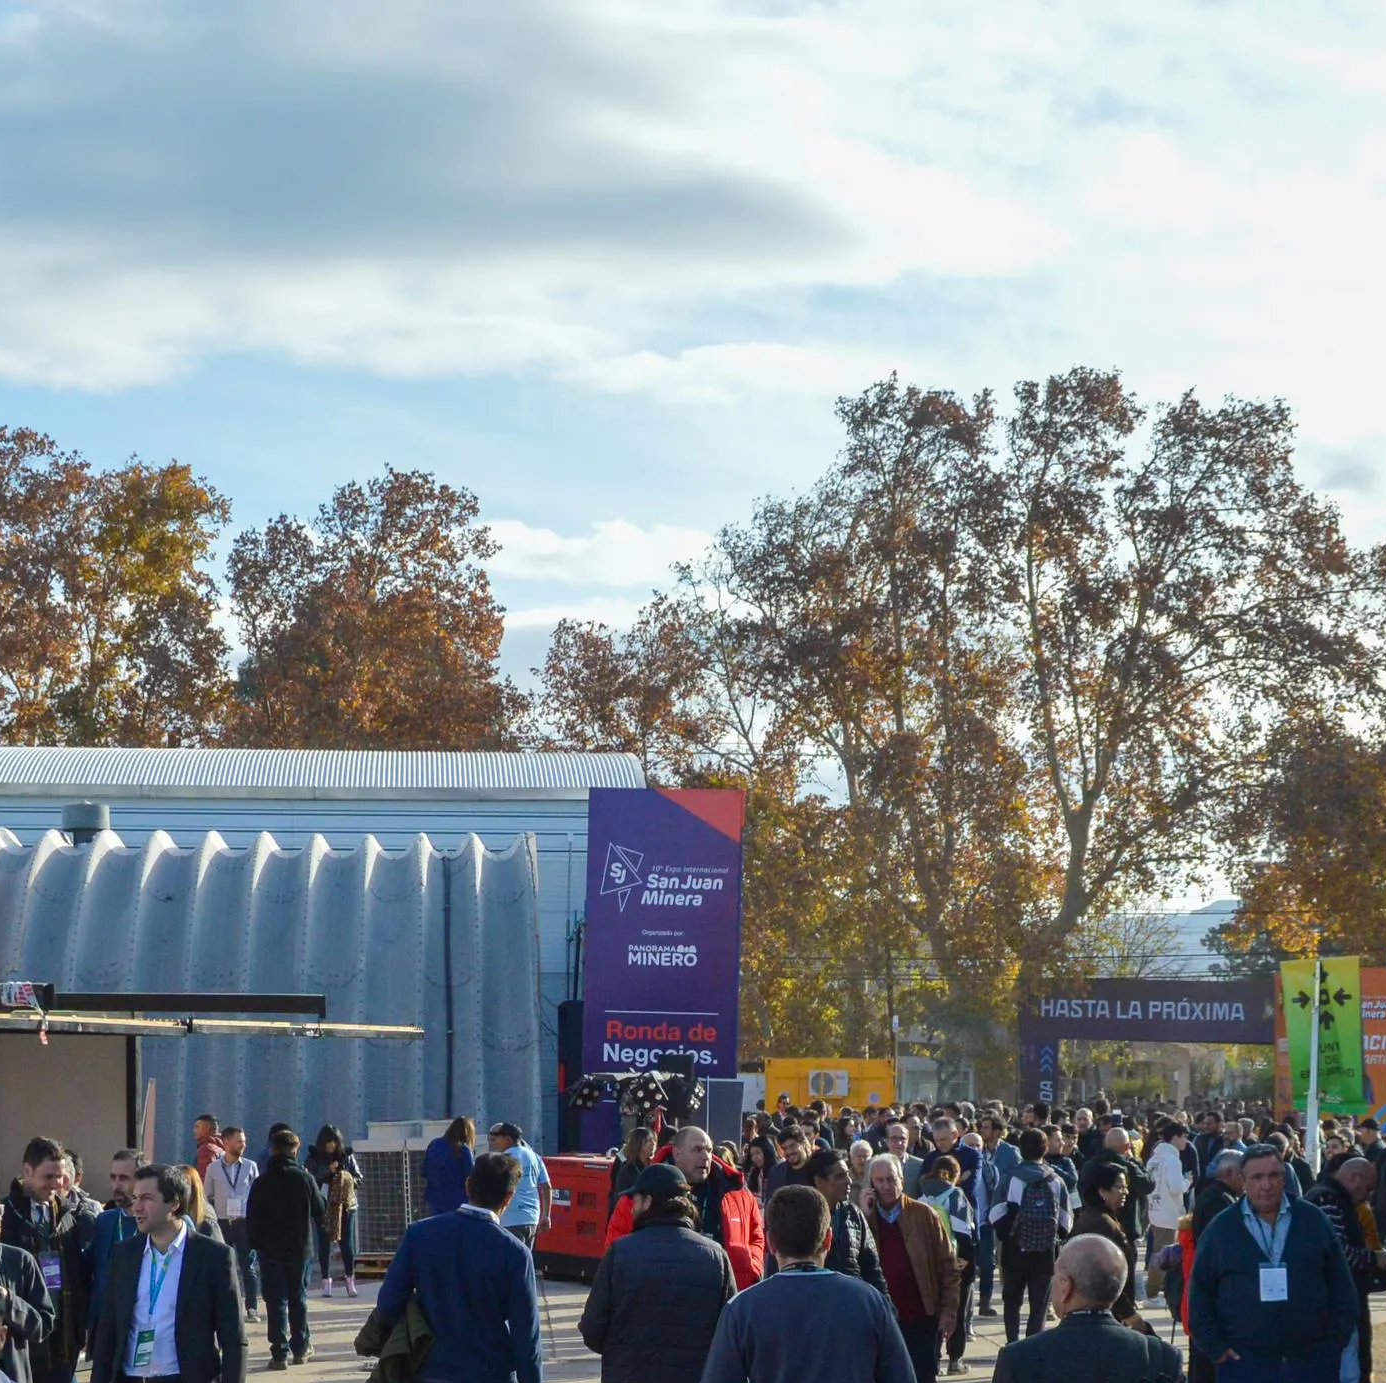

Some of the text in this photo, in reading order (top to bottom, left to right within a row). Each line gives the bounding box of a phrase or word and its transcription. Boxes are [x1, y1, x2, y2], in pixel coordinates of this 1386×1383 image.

[646, 873, 724, 891] San Juan
[640, 889, 703, 907] Minera
[628, 944, 676, 953] PANORAMA
[628, 952, 698, 967] MINERO
[1040, 997, 1245, 1021] HASTA LA PRÓXIMA
[606, 1019, 718, 1042] Ronda de
